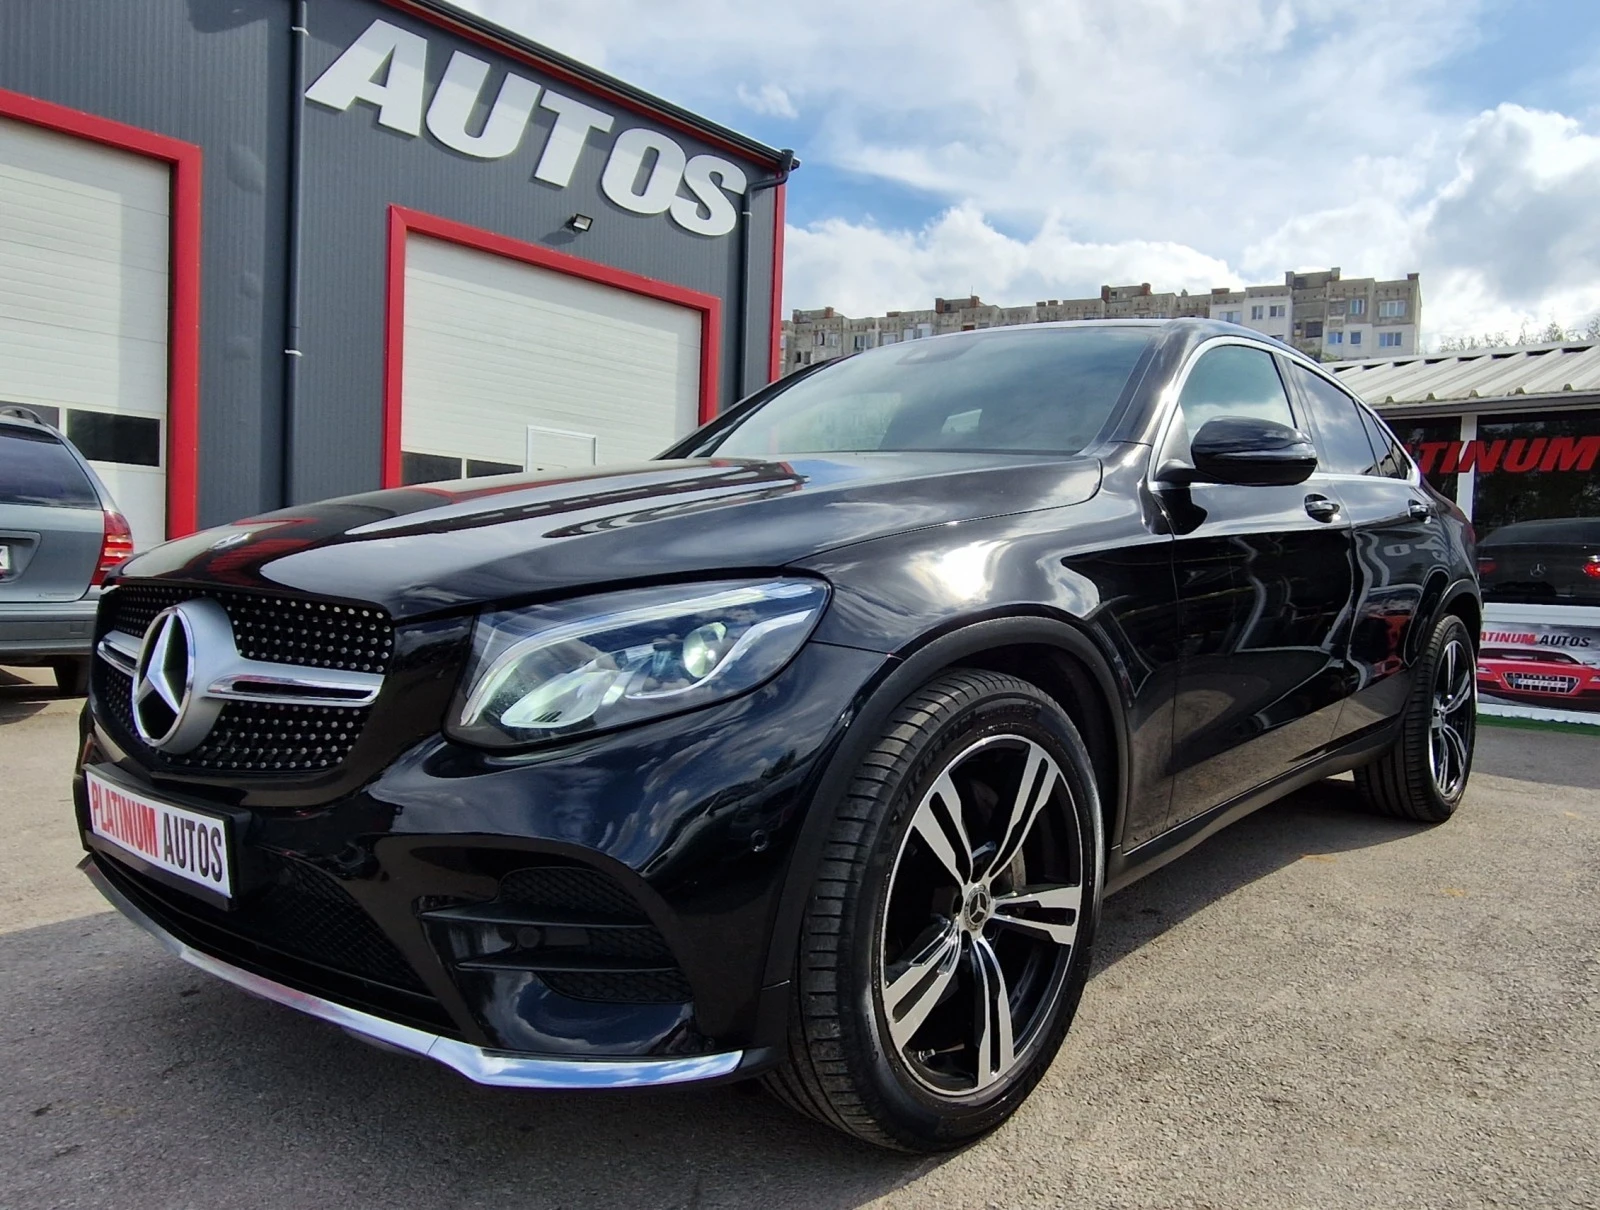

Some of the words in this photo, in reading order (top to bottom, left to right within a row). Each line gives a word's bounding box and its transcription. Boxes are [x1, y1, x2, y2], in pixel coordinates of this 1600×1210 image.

[304, 18, 748, 236] AUTOS
[1404, 435, 1600, 473] TINUM
[1538, 634, 1591, 648] AUTOS
[91, 780, 159, 858] PLATINUM
[163, 812, 223, 883] AUTOS
